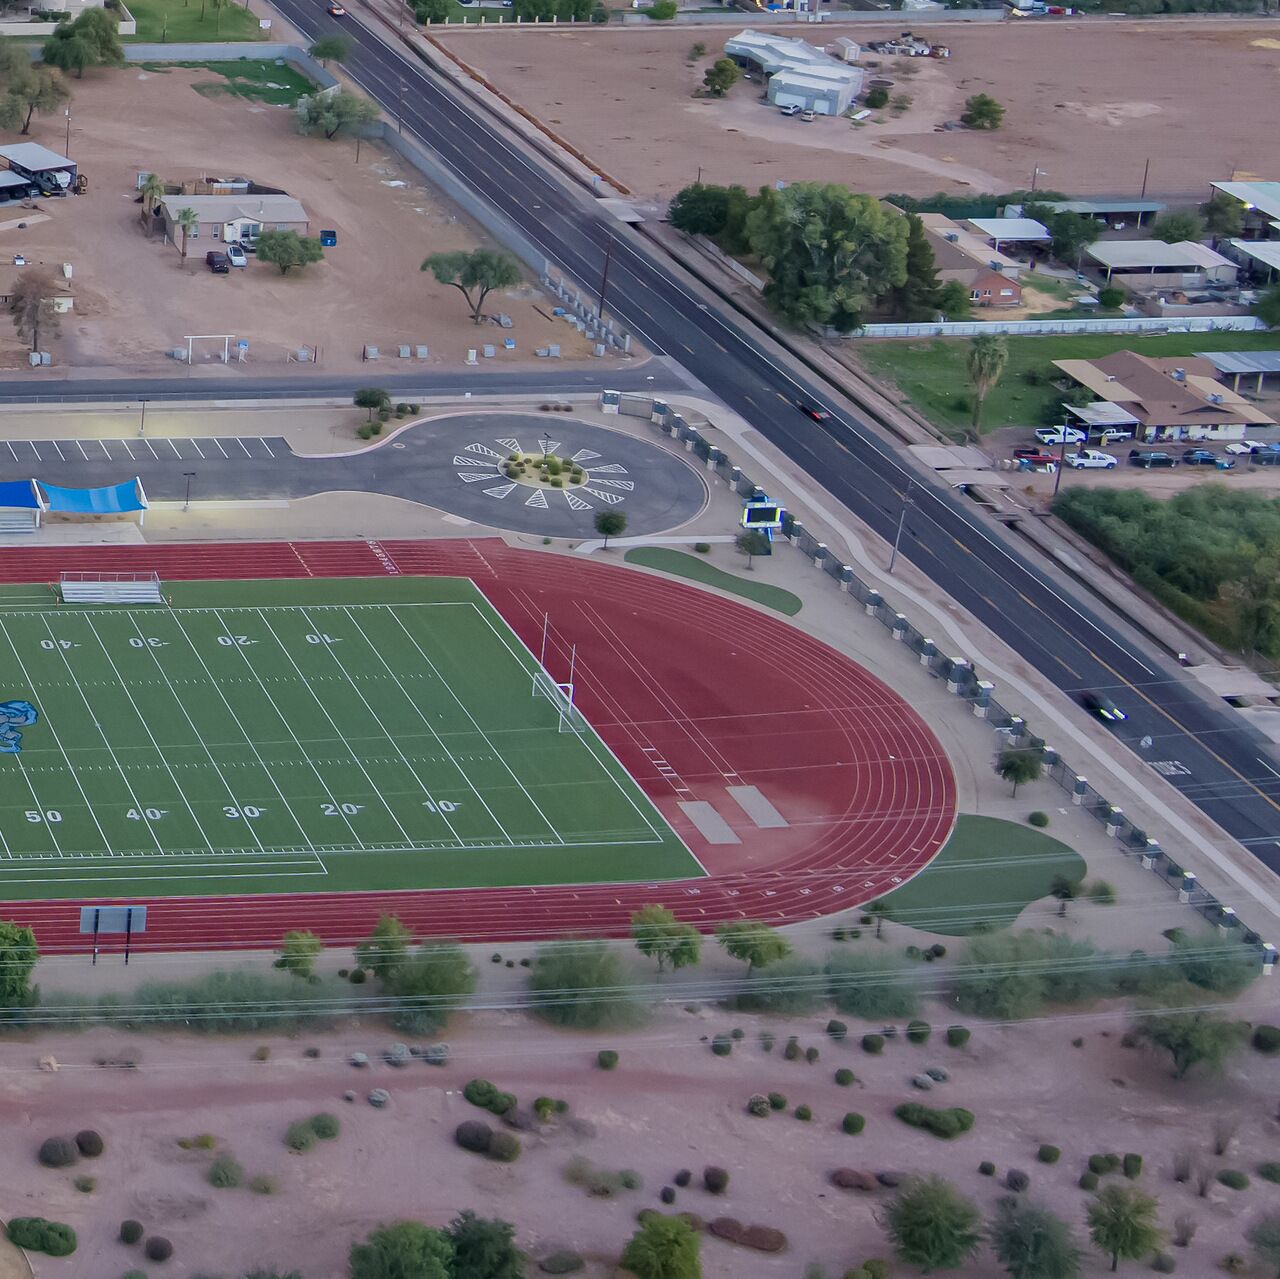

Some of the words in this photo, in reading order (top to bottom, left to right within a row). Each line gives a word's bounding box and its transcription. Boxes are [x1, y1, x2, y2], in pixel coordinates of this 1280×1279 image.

[40, 639, 72, 650] 40
[128, 637, 164, 648] 30
[217, 635, 252, 646] 20
[305, 633, 337, 644] 10
[24, 810, 63, 823] 50
[126, 808, 162, 820] 40
[222, 805, 261, 819] 30
[320, 803, 358, 816] 20
[422, 800, 456, 813] 10
